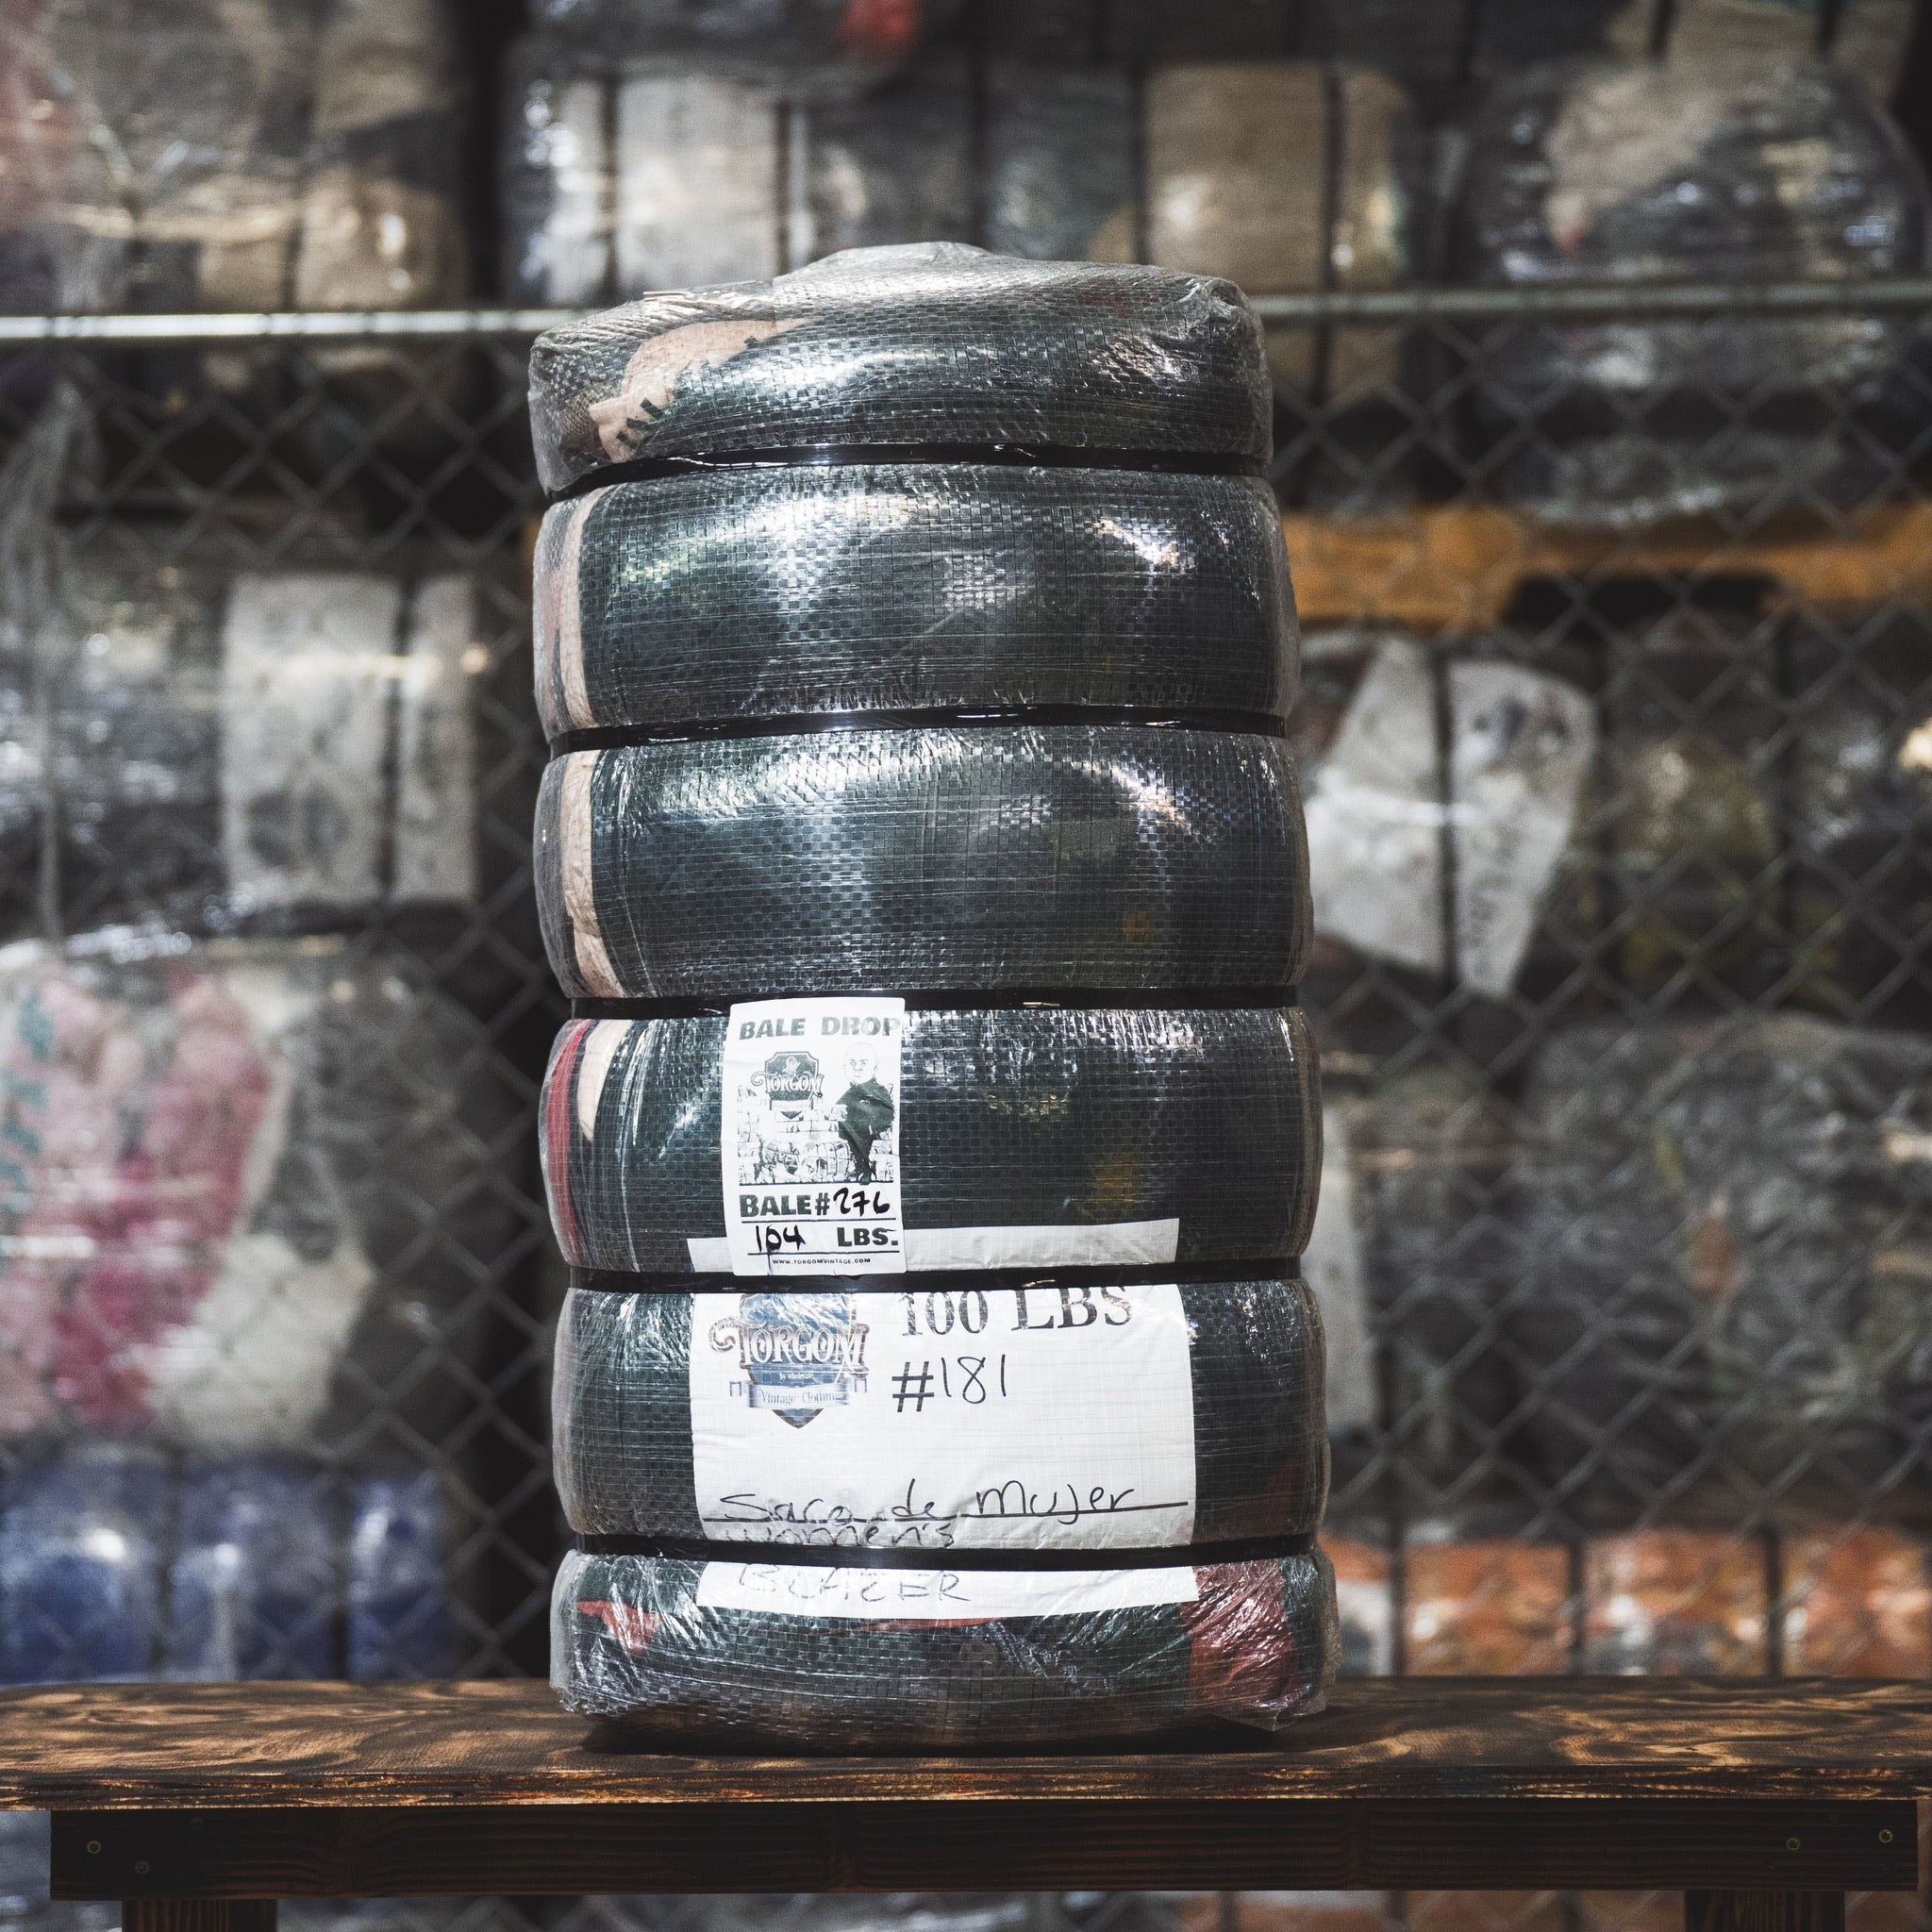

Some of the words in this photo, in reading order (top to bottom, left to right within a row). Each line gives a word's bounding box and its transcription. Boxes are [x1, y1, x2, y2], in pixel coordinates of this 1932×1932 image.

[740, 1018, 806, 1040] BALE
[821, 1016, 901, 1037] DROP
[751, 1070, 824, 1097] TORGOM
[740, 1192, 830, 1217] BALE#
[833, 1187, 891, 1217] 276
[756, 1224, 806, 1253] 104
[837, 1226, 899, 1246] LBS.
[900, 1291, 989, 1337] 100
[1011, 1286, 1132, 1331] LBS
[709, 1318, 870, 1377] TORGOM
[891, 1478, 936, 1518] de
